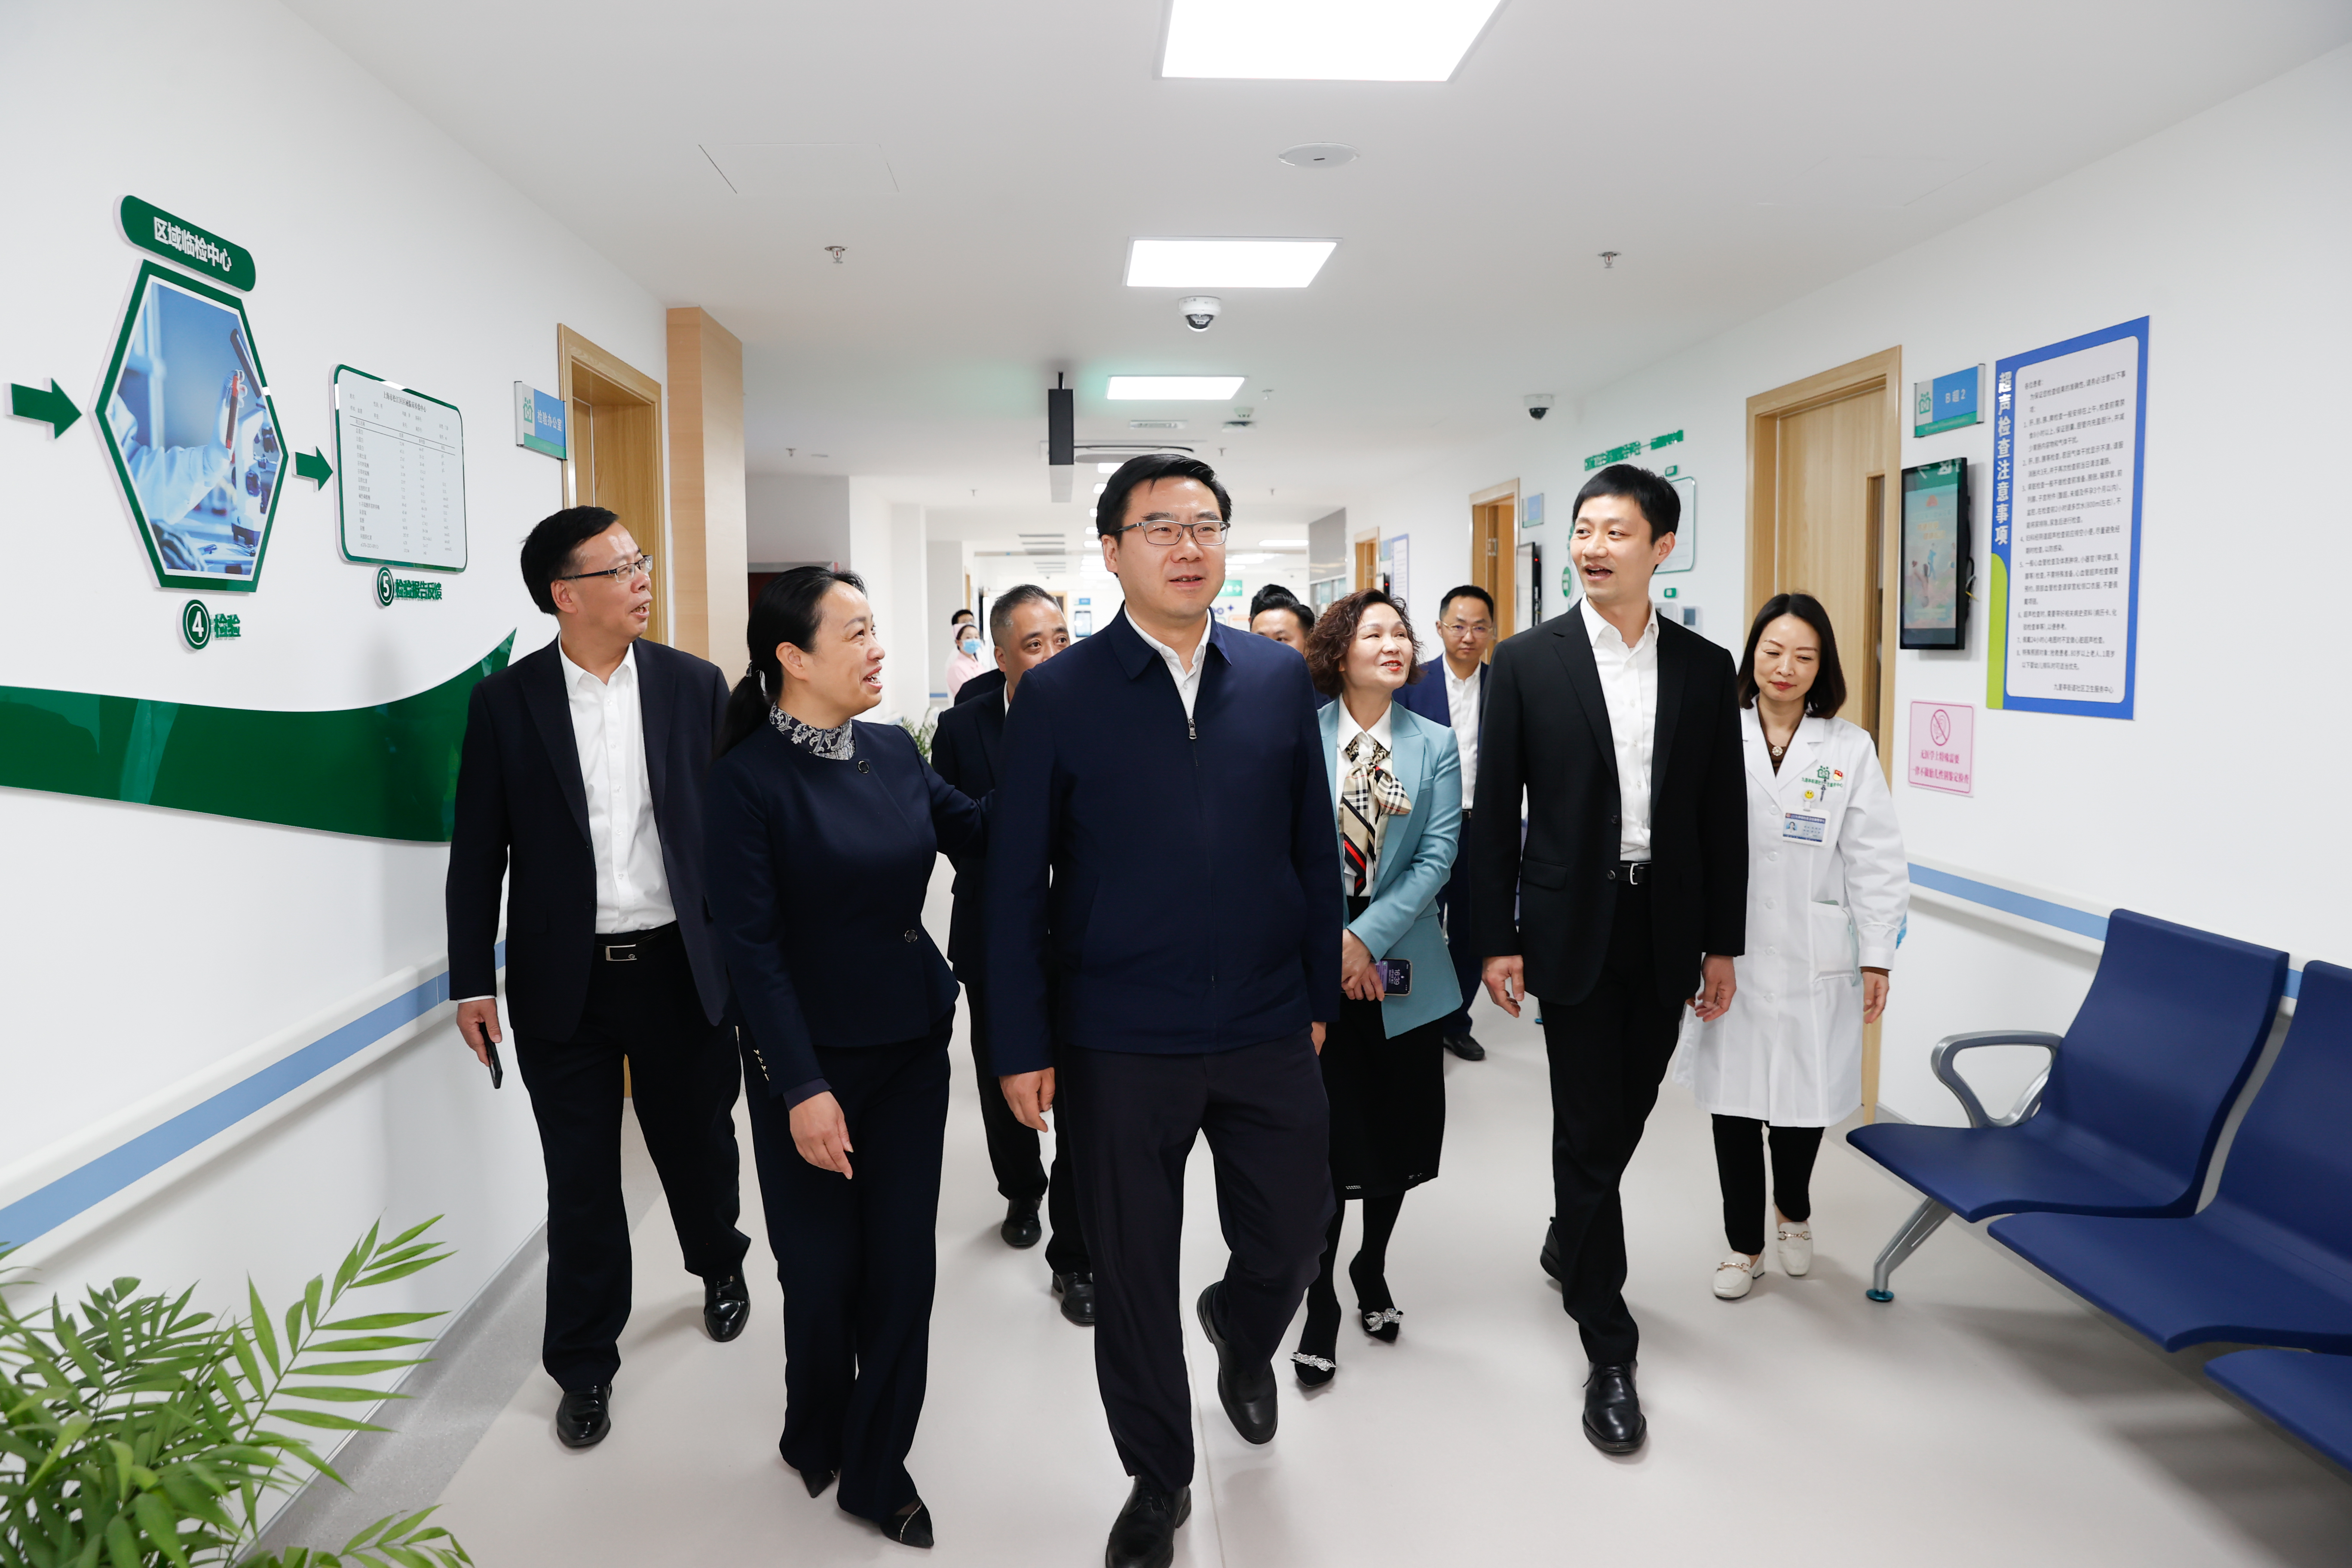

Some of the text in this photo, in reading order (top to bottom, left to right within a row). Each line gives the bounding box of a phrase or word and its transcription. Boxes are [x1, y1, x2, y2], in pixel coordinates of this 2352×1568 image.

[153, 216, 232, 272] 区域临检中心
[1995, 371, 2012, 545] 超声检查注意事项
[383, 576, 389, 597] 5
[395, 579, 442, 599] 检验报告反馈
[192, 611, 204, 637] 4
[213, 614, 241, 638] 检验
